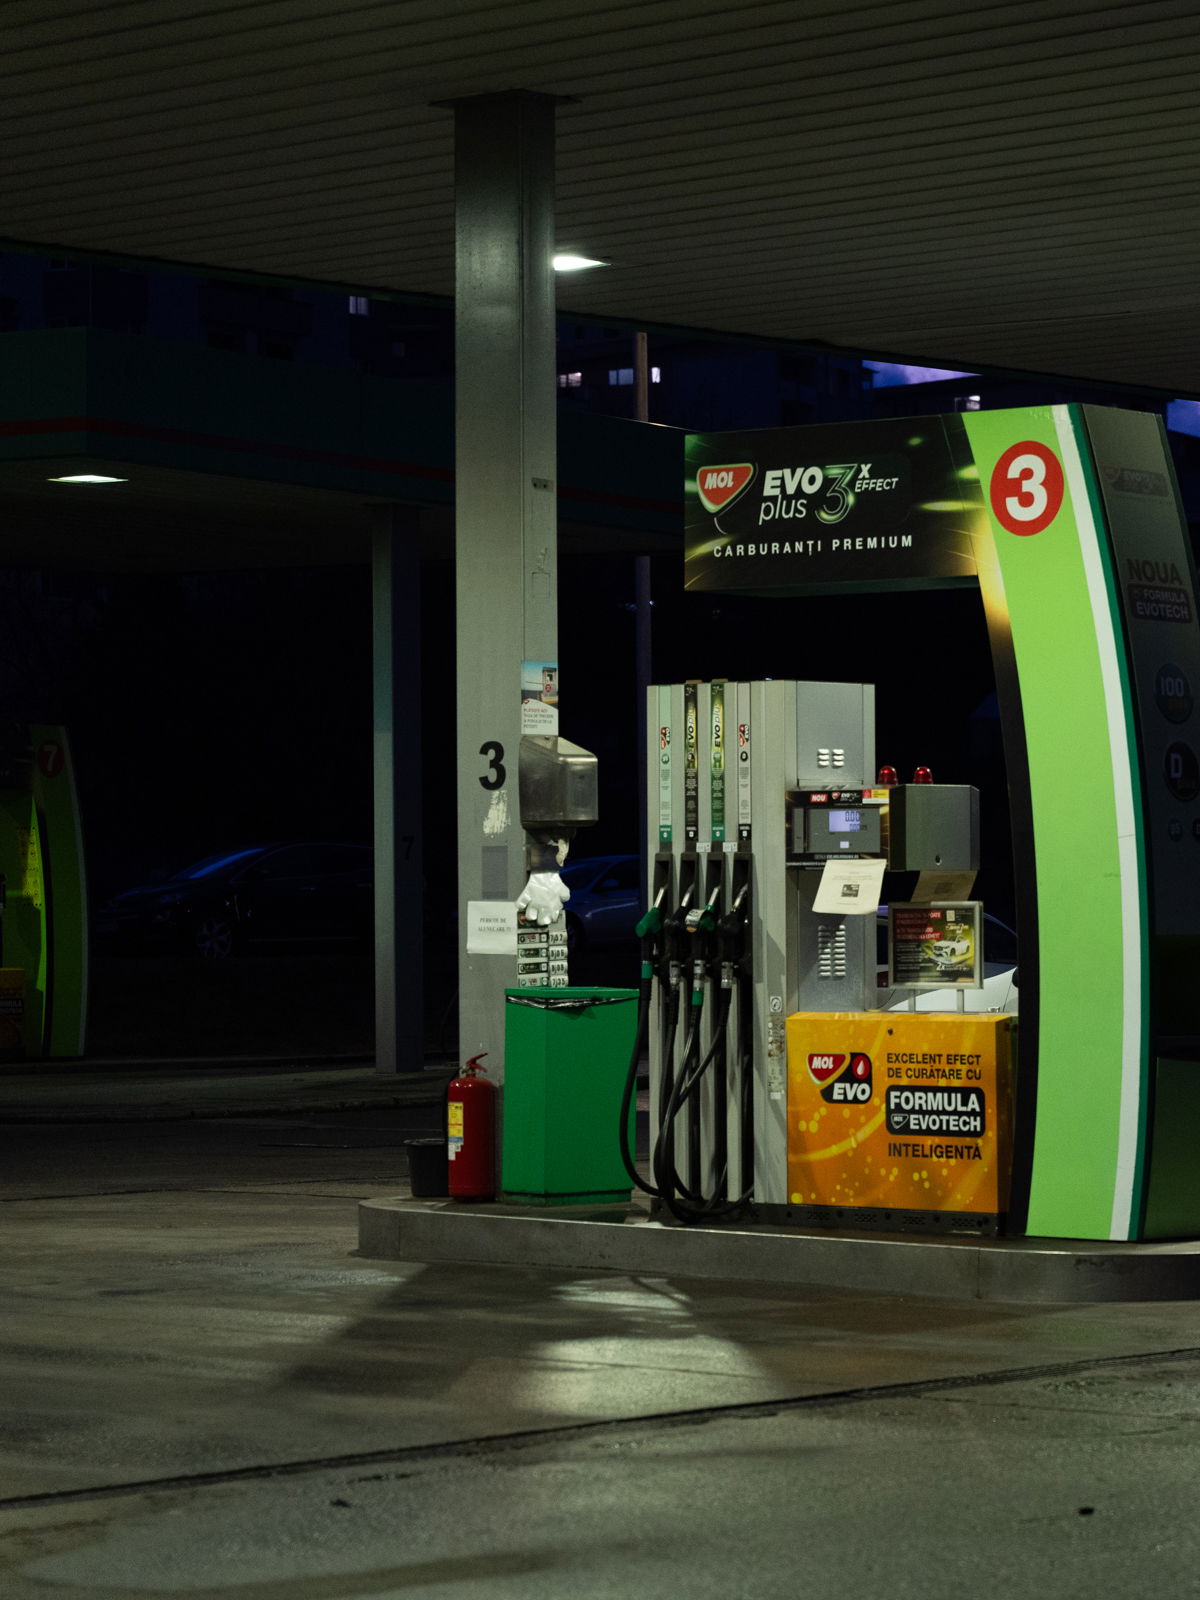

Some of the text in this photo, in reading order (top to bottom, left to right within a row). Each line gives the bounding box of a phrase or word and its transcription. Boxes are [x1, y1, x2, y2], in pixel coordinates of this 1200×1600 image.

[705, 471, 735, 490] MOL
[762, 466, 823, 497] EVO
[855, 477, 899, 492] EFFECT
[1005, 453, 1047, 523] 3
[758, 496, 807, 526] plus
[713, 534, 913, 558] CARBURANȚI PREMIUM
[1128, 559, 1182, 585] NOUA
[1143, 588, 1188, 603] FORMULA
[1135, 602, 1189, 620] EVOTECH
[43, 745, 58, 771] 7
[479, 741, 507, 790] 3
[811, 1056, 834, 1069] MOL
[887, 1053, 982, 1065] EXCELENT EFECT
[887, 1067, 902, 1078] DE
[966, 1069, 982, 1080] CU
[832, 1082, 871, 1100] EVO
[889, 1091, 980, 1112] FORMULA
[909, 1115, 981, 1132] EVOTECH
